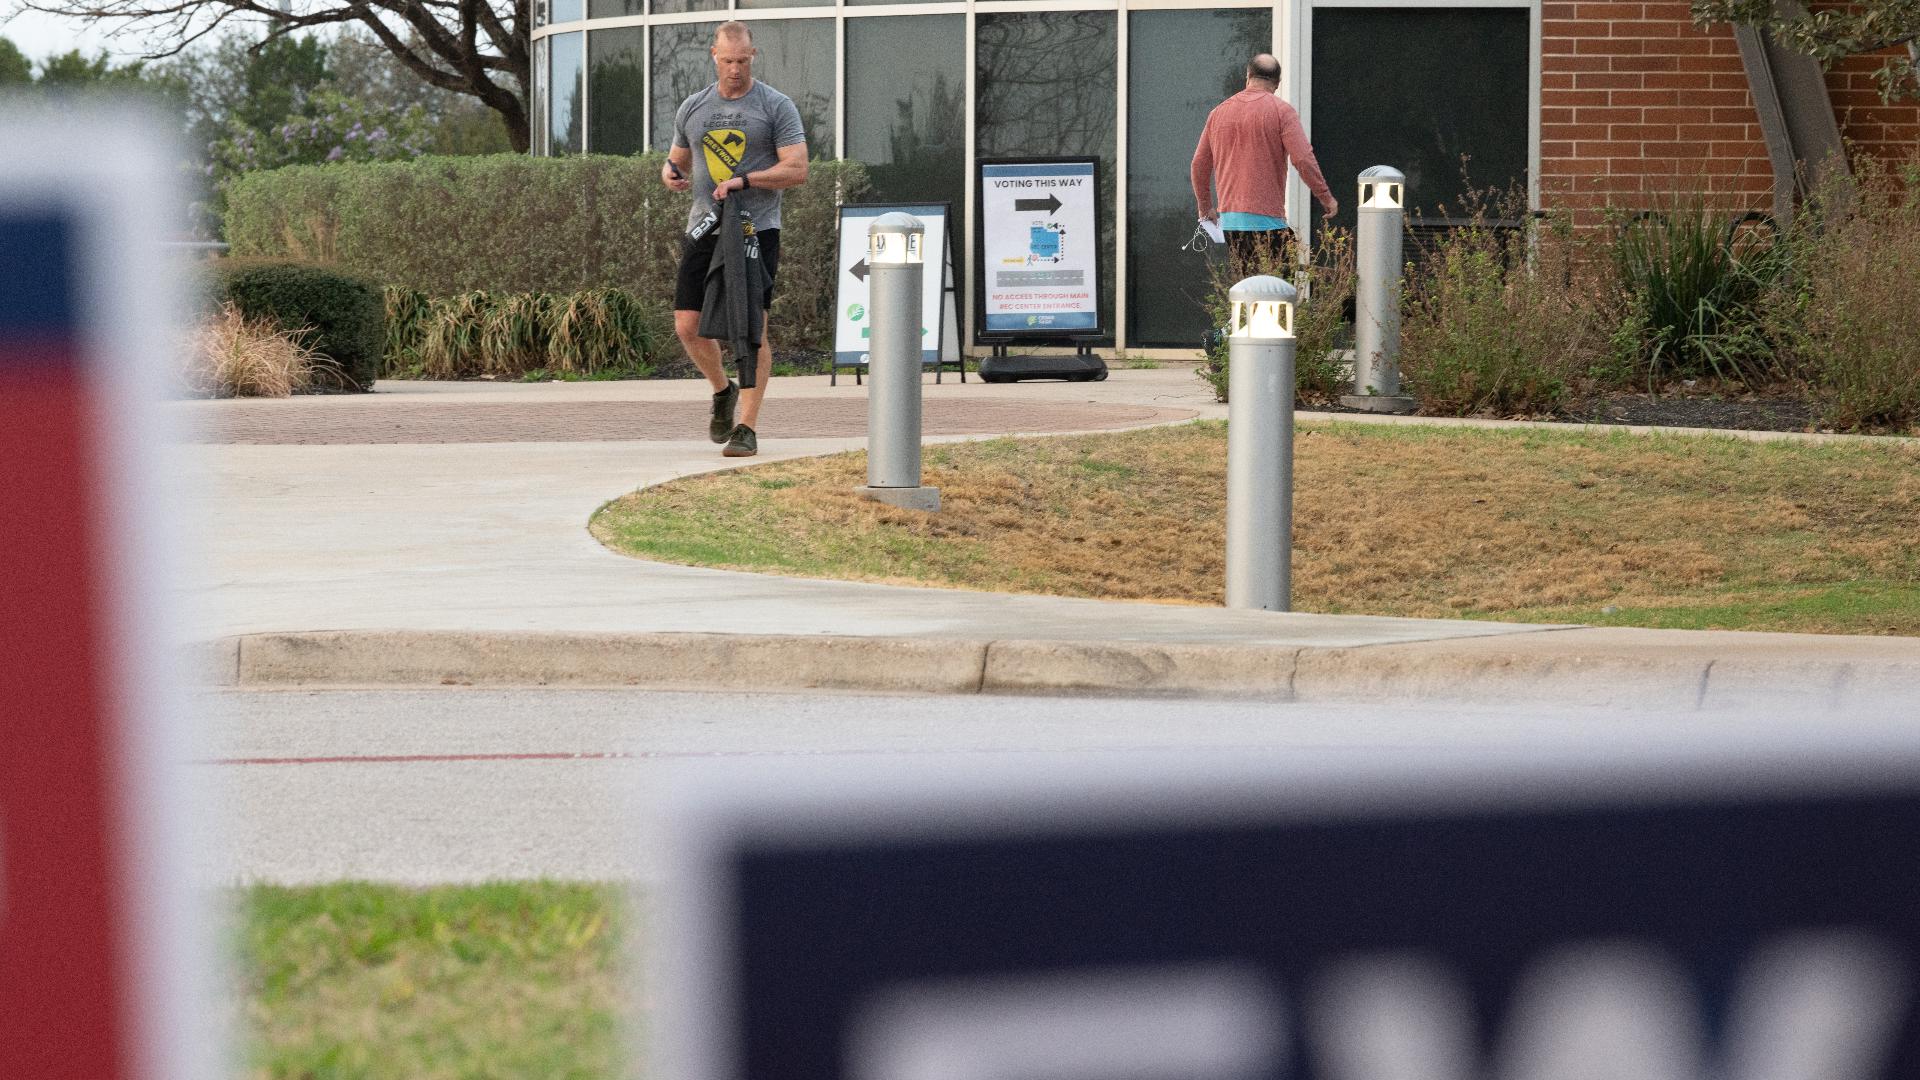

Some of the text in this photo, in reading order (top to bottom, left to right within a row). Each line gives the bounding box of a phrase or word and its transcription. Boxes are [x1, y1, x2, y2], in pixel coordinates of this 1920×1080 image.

[703, 119, 748, 128] LEGENDS
[703, 136, 738, 167] GREYWOLF
[994, 178, 1083, 188] VOTING THIS WAY
[992, 293, 1004, 301] NO
[1034, 292, 1069, 300] THROUGH
